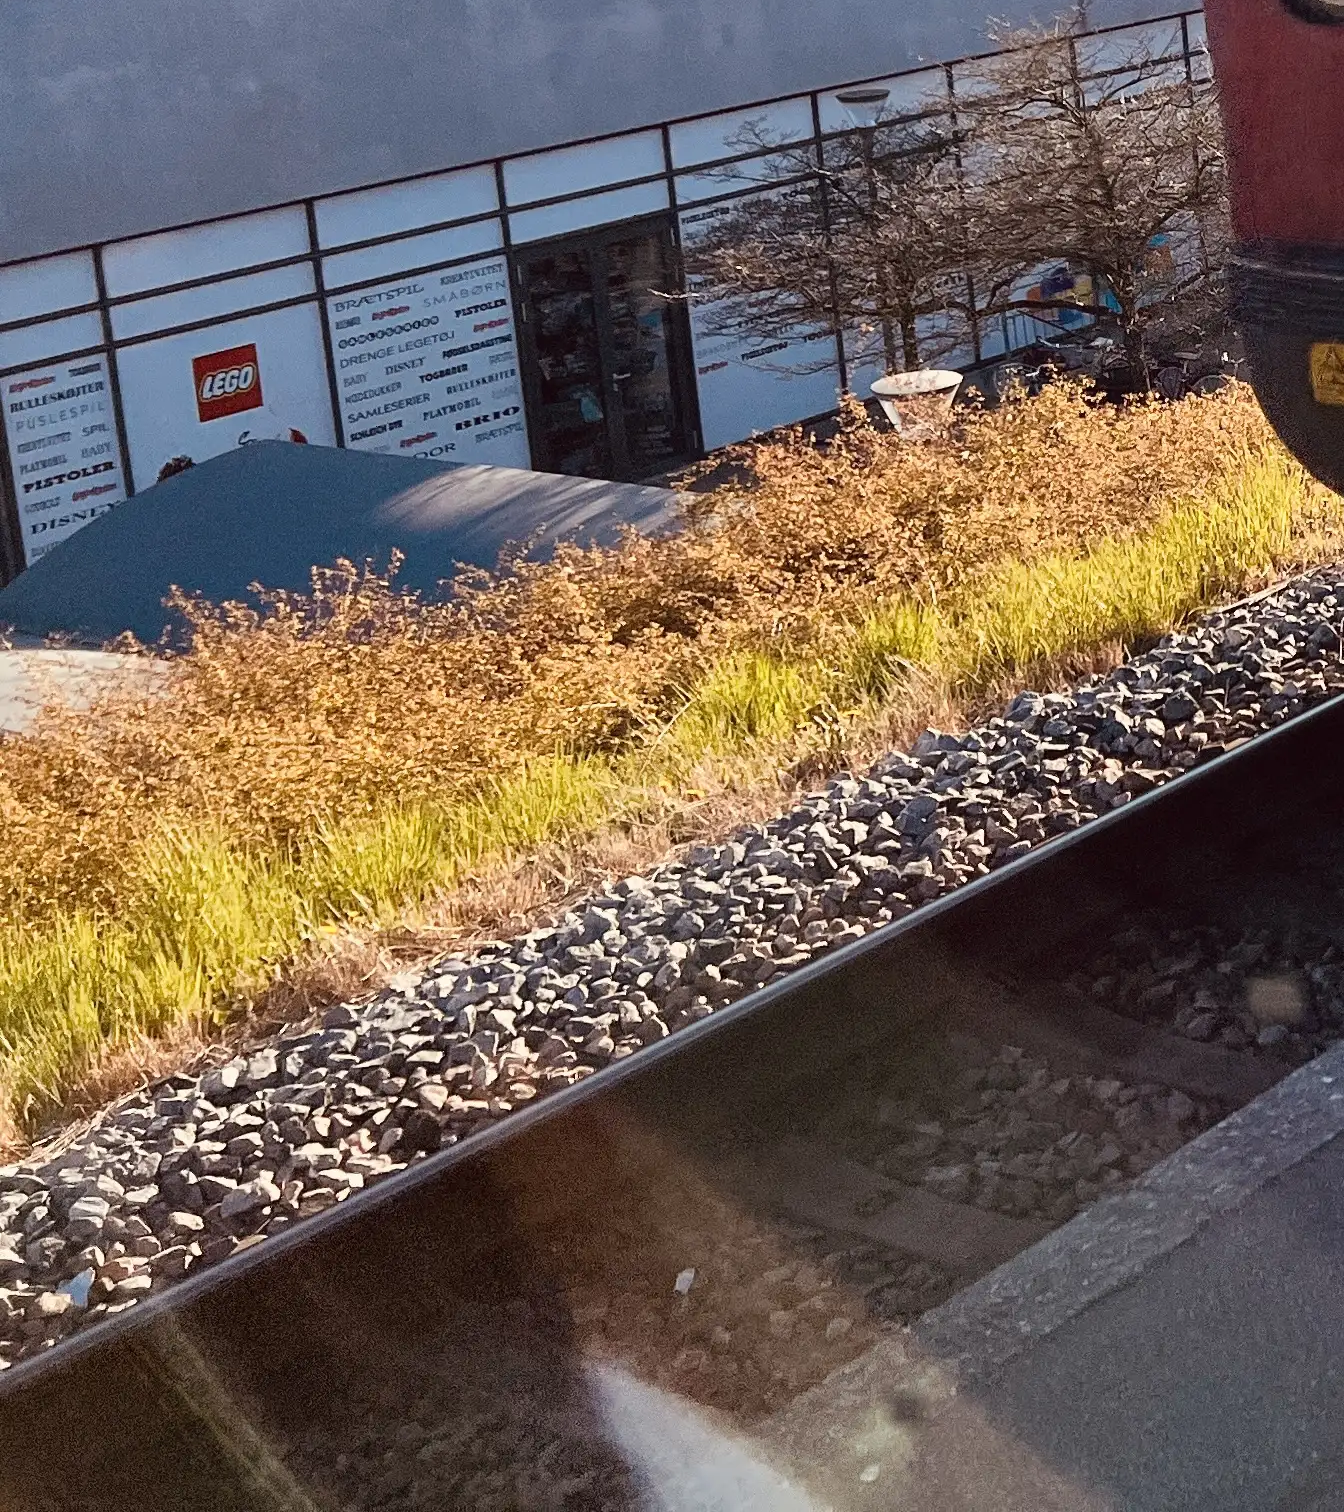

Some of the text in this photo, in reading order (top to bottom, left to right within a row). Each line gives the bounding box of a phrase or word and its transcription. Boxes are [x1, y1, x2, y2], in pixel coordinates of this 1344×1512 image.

[334, 283, 425, 313] BRÆTSPIL
[340, 345, 395, 369] DRENGE
[398, 330, 455, 354] LEGETØJ
[201, 364, 255, 401] LEGO
[16, 400, 107, 432] PUSLESPIL
[347, 393, 431, 424] SAMLESERIER
[455, 406, 521, 431] BRIO
[23, 461, 116, 494] PISTOLER
